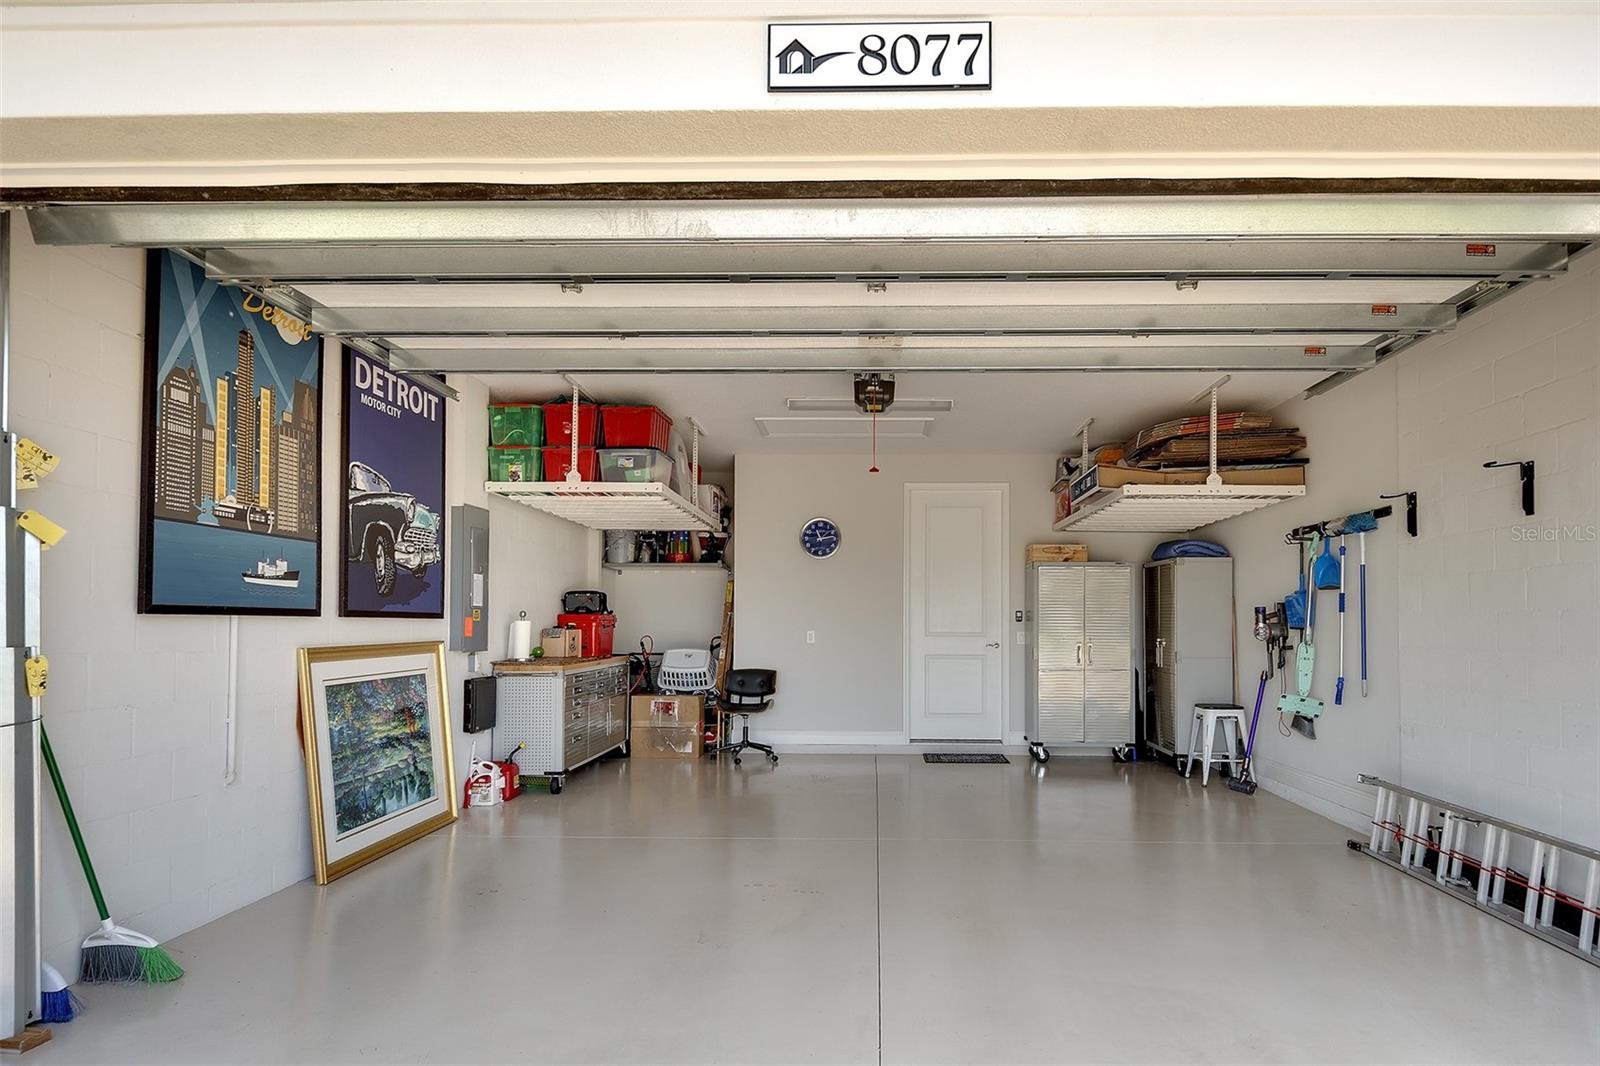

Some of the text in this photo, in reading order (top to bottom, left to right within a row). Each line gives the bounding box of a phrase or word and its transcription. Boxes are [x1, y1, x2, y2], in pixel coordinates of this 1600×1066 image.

[857, 34, 983, 76] 8077
[355, 356, 439, 422] DETROIT
[361, 393, 402, 419] MOTOR CITY
